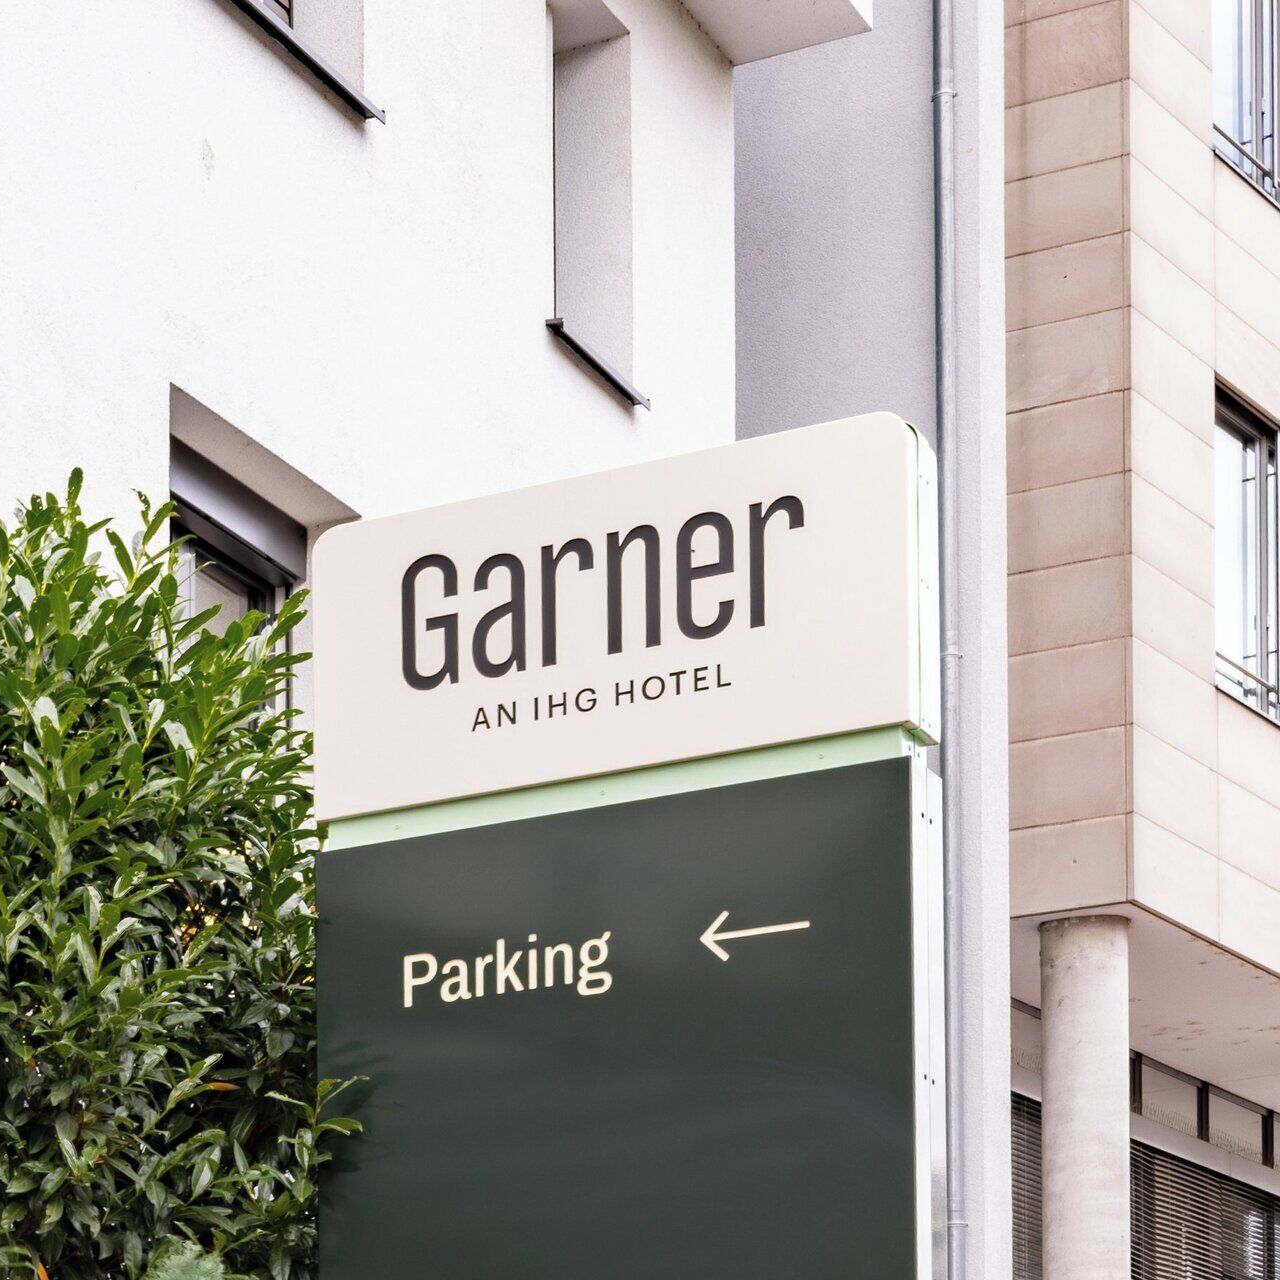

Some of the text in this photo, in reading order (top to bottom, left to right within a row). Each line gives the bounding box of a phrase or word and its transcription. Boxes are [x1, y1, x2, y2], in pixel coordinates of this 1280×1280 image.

[401, 495, 805, 691] Garner
[471, 663, 732, 732] AN IHG HOTEL
[403, 930, 613, 1008] Parking
